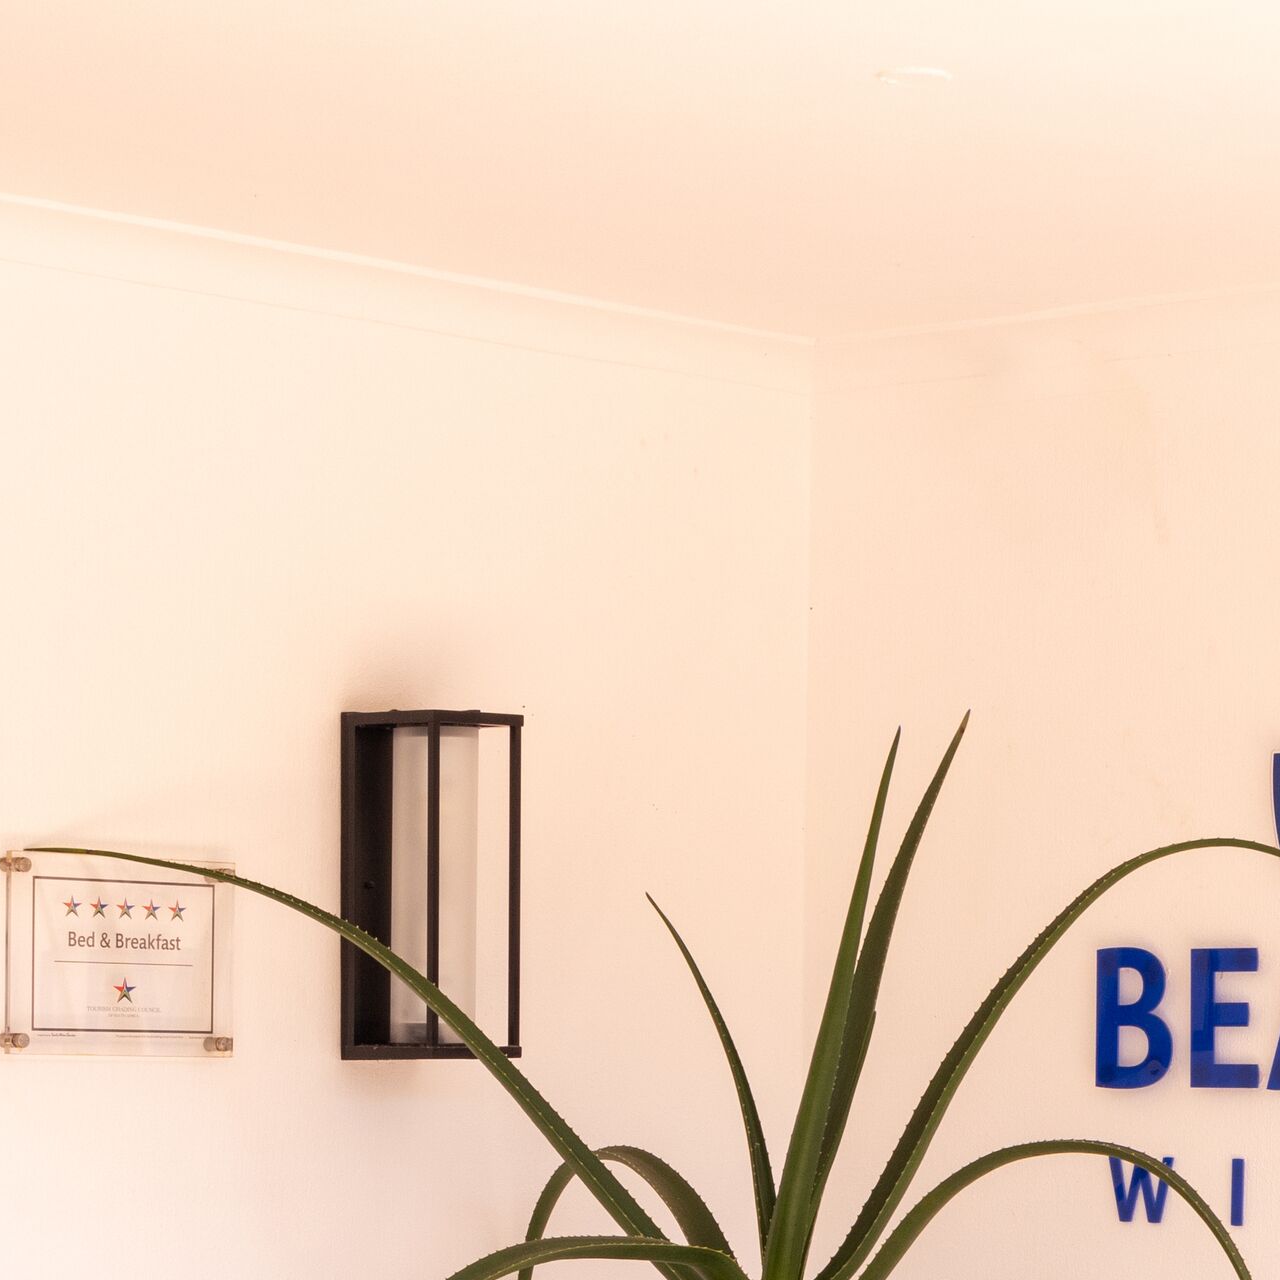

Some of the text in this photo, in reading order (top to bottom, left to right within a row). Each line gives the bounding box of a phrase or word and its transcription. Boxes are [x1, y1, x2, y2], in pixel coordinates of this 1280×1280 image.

[68, 931, 181, 950] Bed & Breakfast
